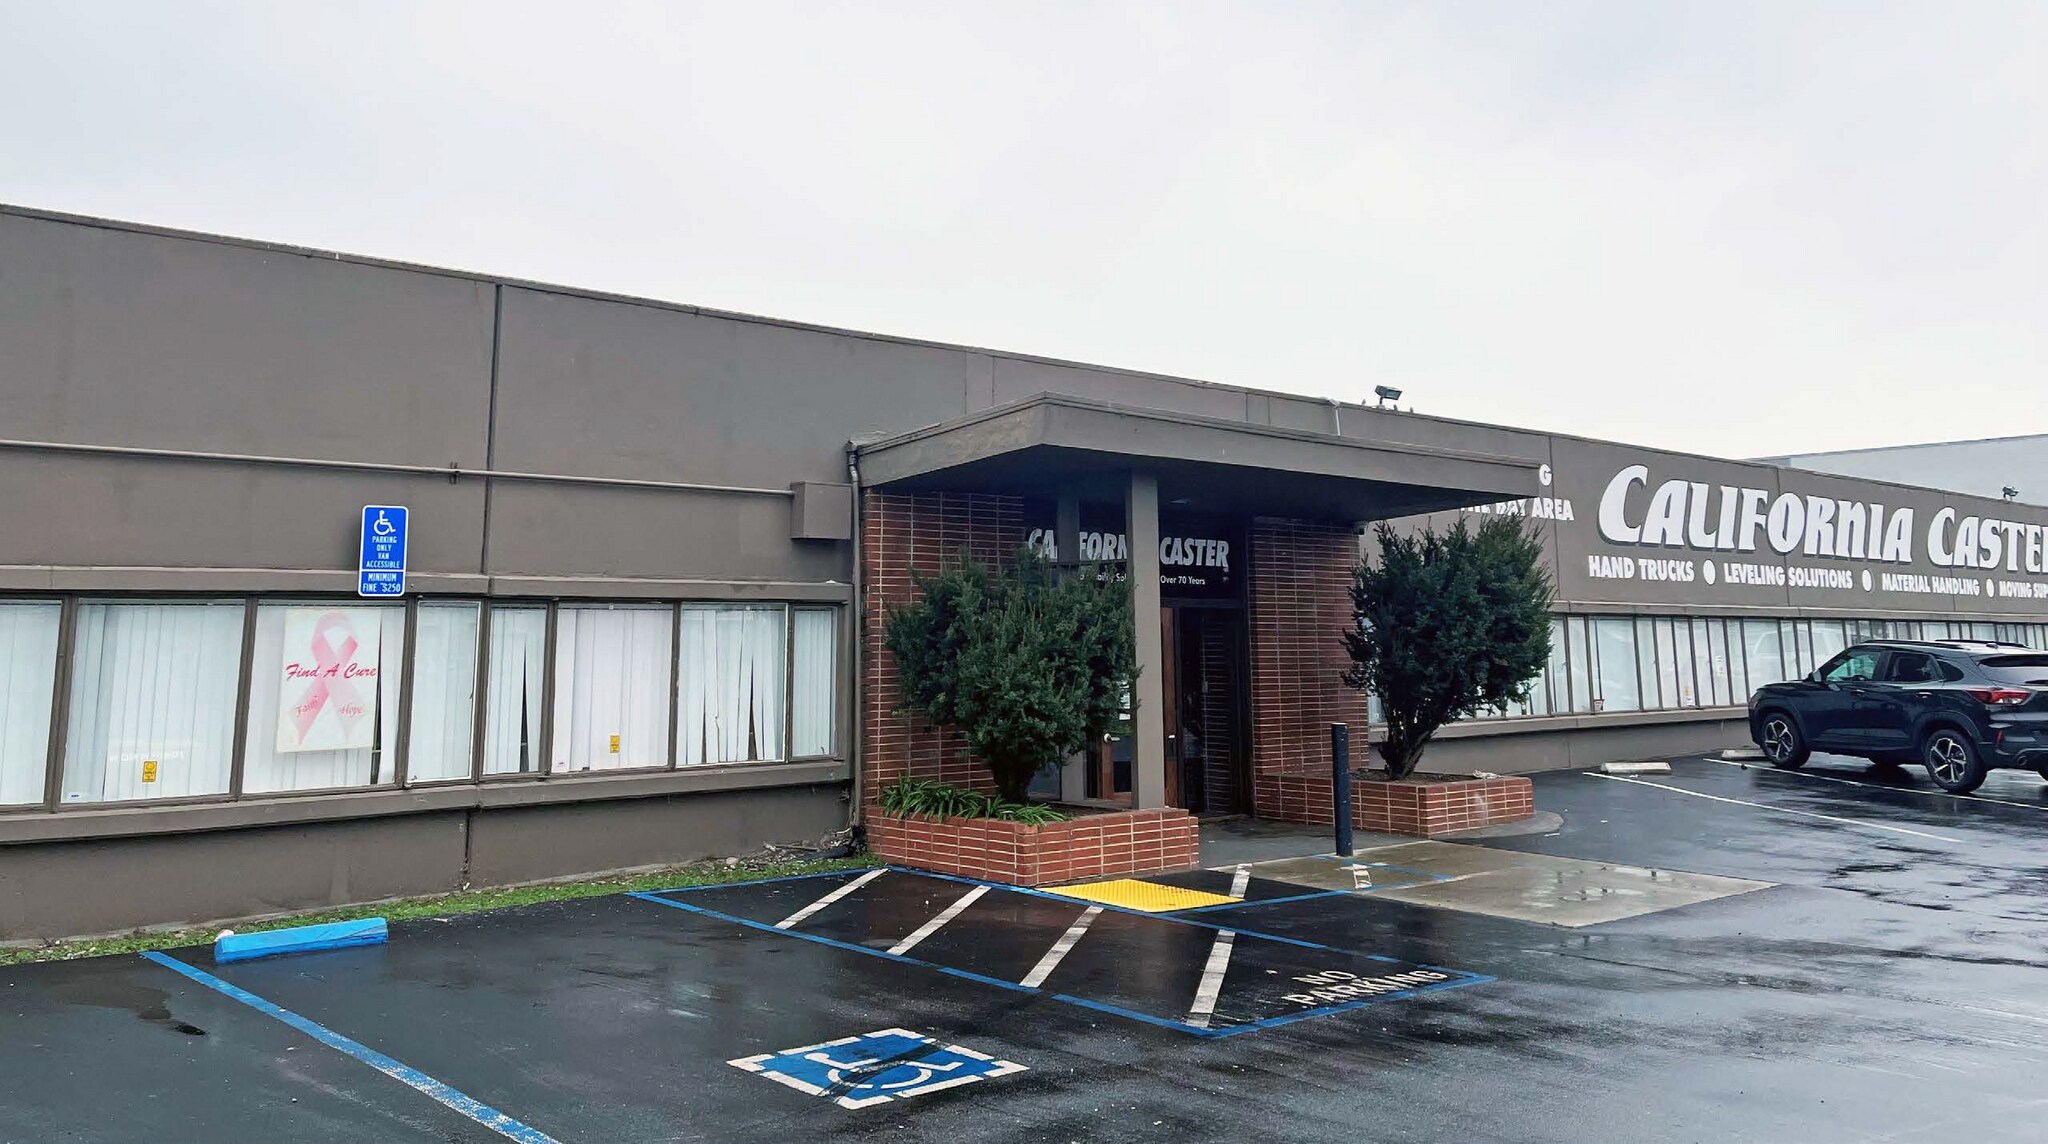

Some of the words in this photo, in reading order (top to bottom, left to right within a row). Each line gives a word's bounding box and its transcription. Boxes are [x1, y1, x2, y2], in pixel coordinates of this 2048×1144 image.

[1532, 497, 1574, 521] AREA
[1598, 464, 1914, 564] CALIFORNIA
[372, 536, 397, 544] PARKING
[1159, 537, 1229, 567] CASTER
[366, 560, 400, 568] ACCESSIBLE
[368, 573, 397, 581] MINIMUM
[1160, 575, 1176, 584] Over
[1178, 576, 1187, 584] 70
[1188, 576, 1206, 585] Years
[1588, 555, 1635, 579] HAND
[1638, 558, 1695, 582] TRUCKS
[1723, 563, 1786, 586] LEVELING
[1788, 567, 1853, 589] SOLUTIONS
[1882, 573, 1931, 593] MATERIAL
[1932, 576, 1980, 596] HANDLING
[1999, 581, 2032, 598] MOVING
[363, 583, 377, 592] FINE
[286, 663, 320, 681] Find
[323, 663, 340, 678] A
[343, 662, 378, 679] Cure
[1292, 970, 1357, 985] NO
[1281, 970, 1448, 1006] PARKING
